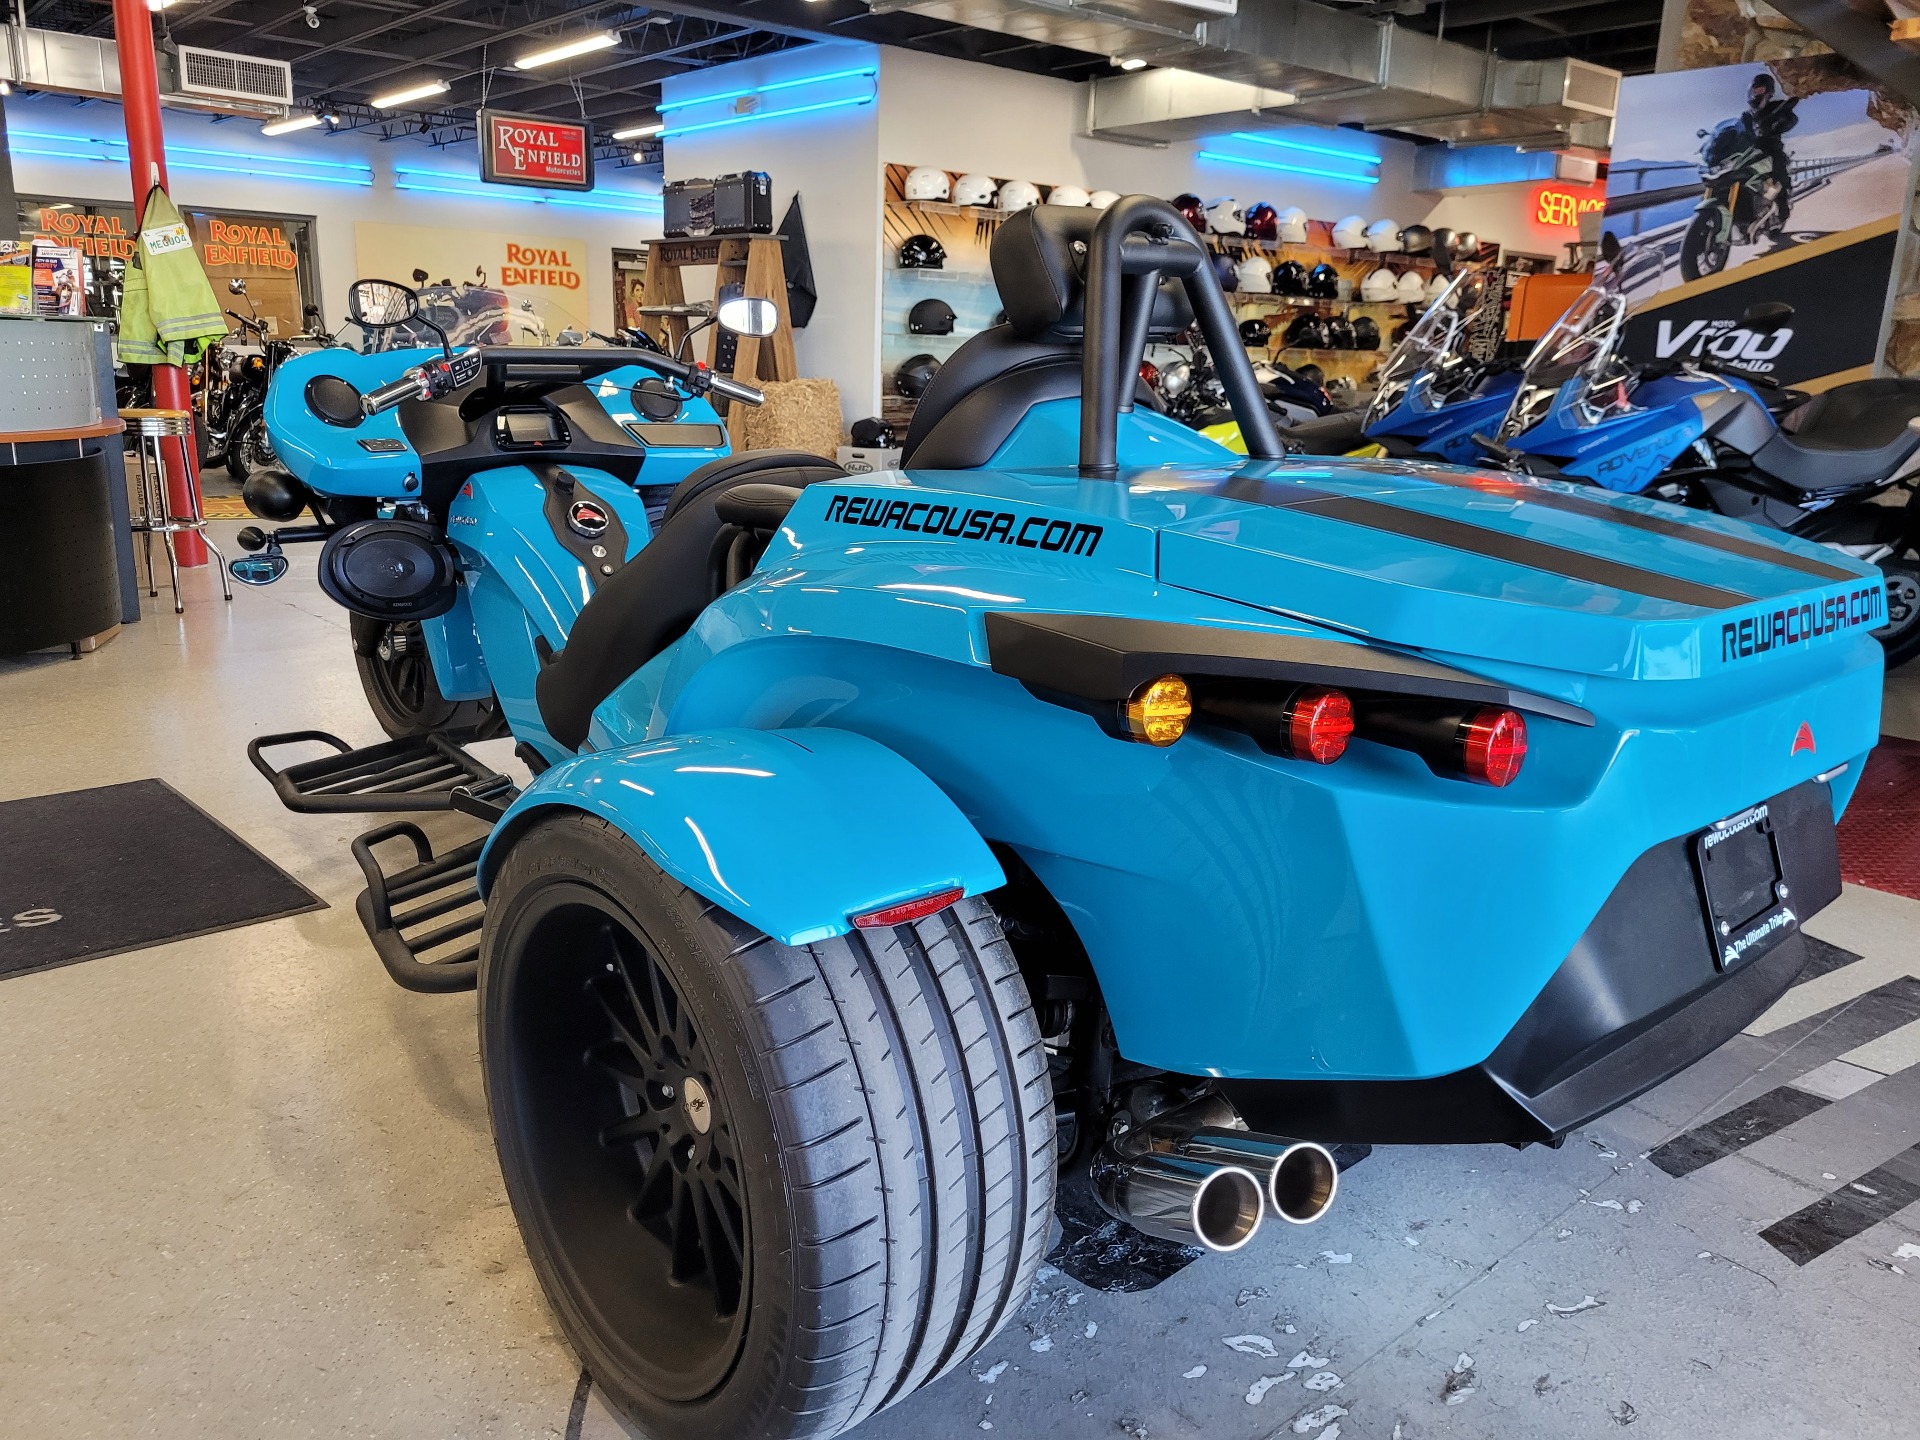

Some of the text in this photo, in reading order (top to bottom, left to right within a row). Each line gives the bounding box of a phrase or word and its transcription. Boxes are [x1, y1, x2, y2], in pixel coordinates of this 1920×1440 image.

[498, 126, 559, 157] ROYAL
[514, 147, 581, 171] ENFIELD
[546, 166, 581, 176] Motorcycles
[40, 208, 127, 235] ROYAL
[209, 219, 286, 247] ROYAL
[34, 234, 137, 261] NFIELD
[204, 244, 297, 270] ENFIELD
[506, 243, 572, 267] ROYAL
[660, 246, 689, 262] ROYAL
[501, 266, 581, 290] ENFIELD
[1711, 320, 1736, 328] MOTO
[824, 494, 1104, 557] REWACOUSA.COM
[1722, 585, 1882, 663] REWACOUSA.COM
[1734, 939, 1747, 953] The
[1745, 923, 1770, 946] Ultimate
